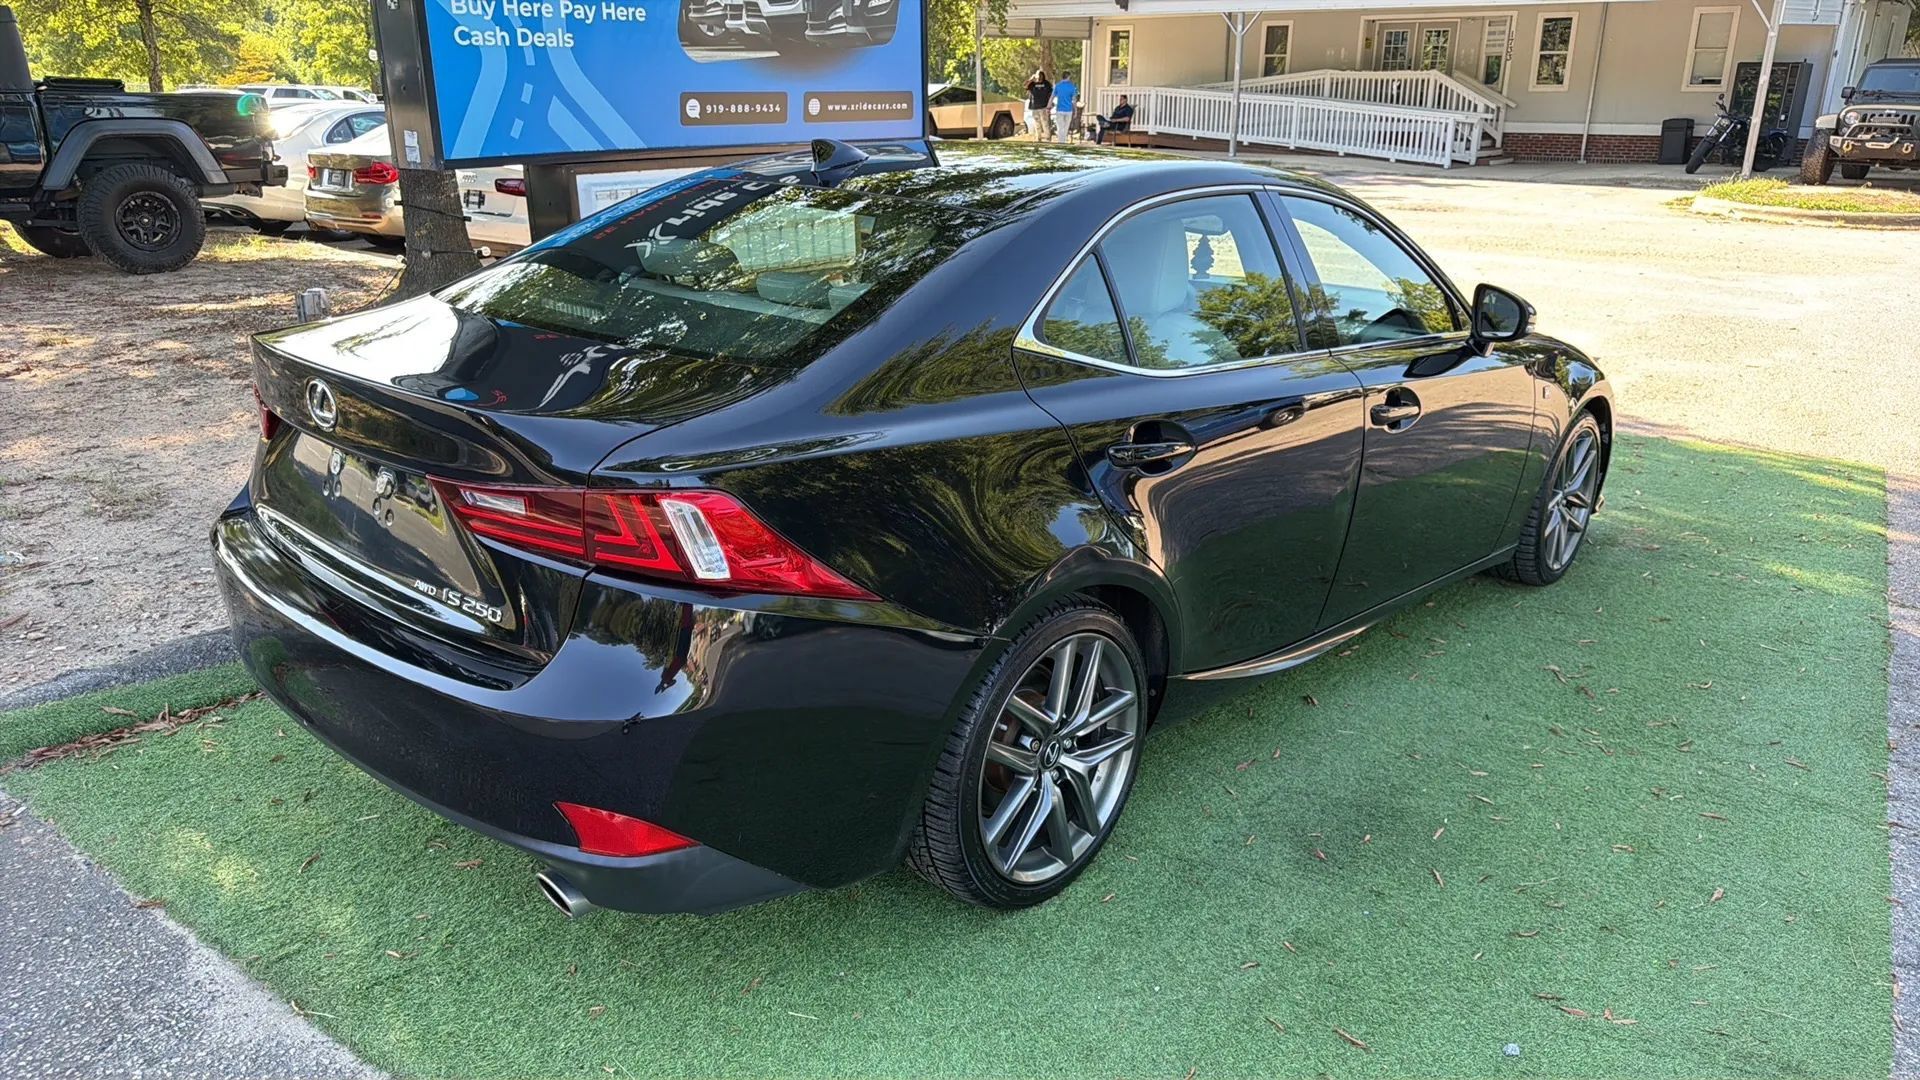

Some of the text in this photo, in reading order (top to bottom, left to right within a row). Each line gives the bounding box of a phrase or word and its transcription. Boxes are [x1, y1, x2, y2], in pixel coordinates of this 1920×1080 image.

[451, 0, 647, 24] Buy Here Pay Here
[453, 25, 575, 48] Cash Deals
[705, 103, 782, 114] 919-888-9434
[827, 102, 908, 112] www.xridecars.com
[413, 579, 437, 596] AWD
